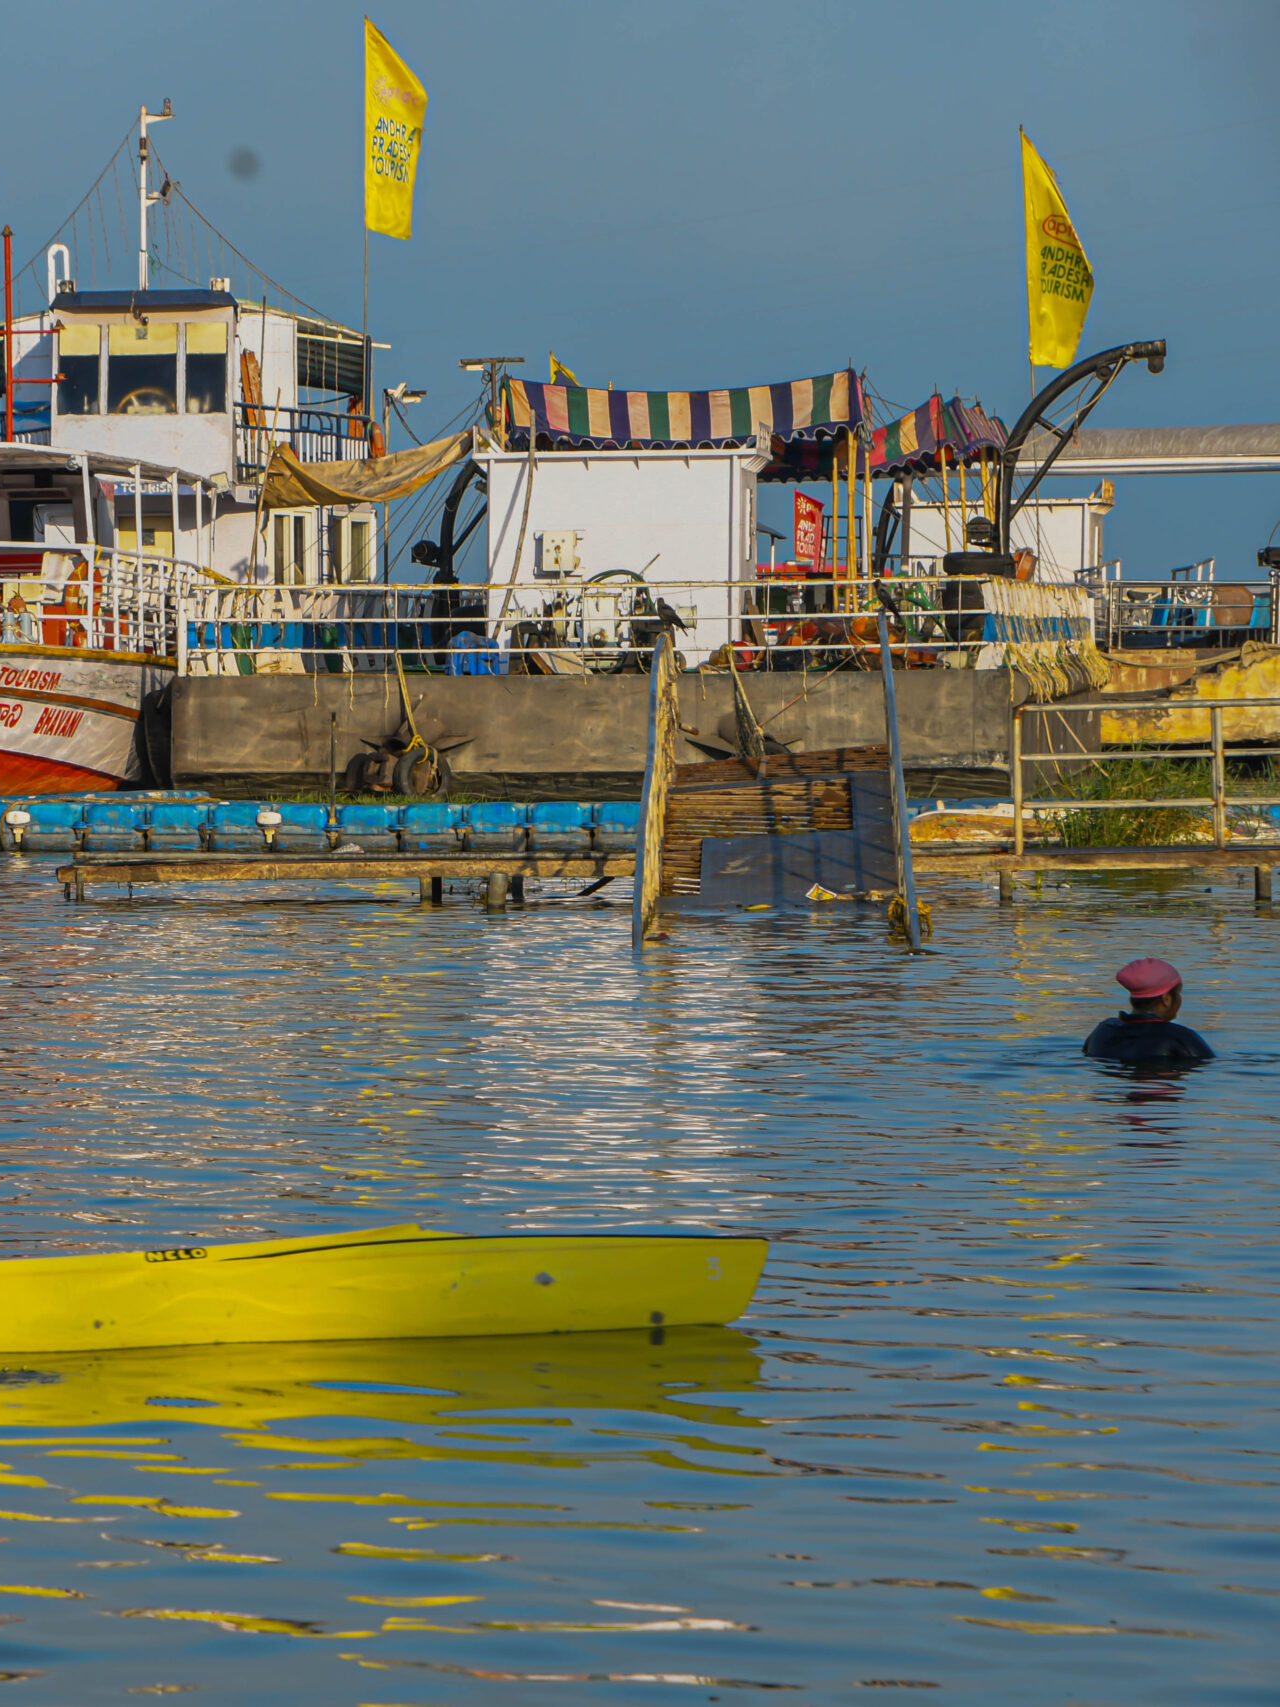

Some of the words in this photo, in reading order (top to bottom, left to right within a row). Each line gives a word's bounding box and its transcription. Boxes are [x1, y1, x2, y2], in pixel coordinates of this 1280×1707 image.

[375, 115, 417, 145] ANDHRA
[33, 706, 85, 739] BHAVANI
[146, 1247, 207, 1263] NELO
